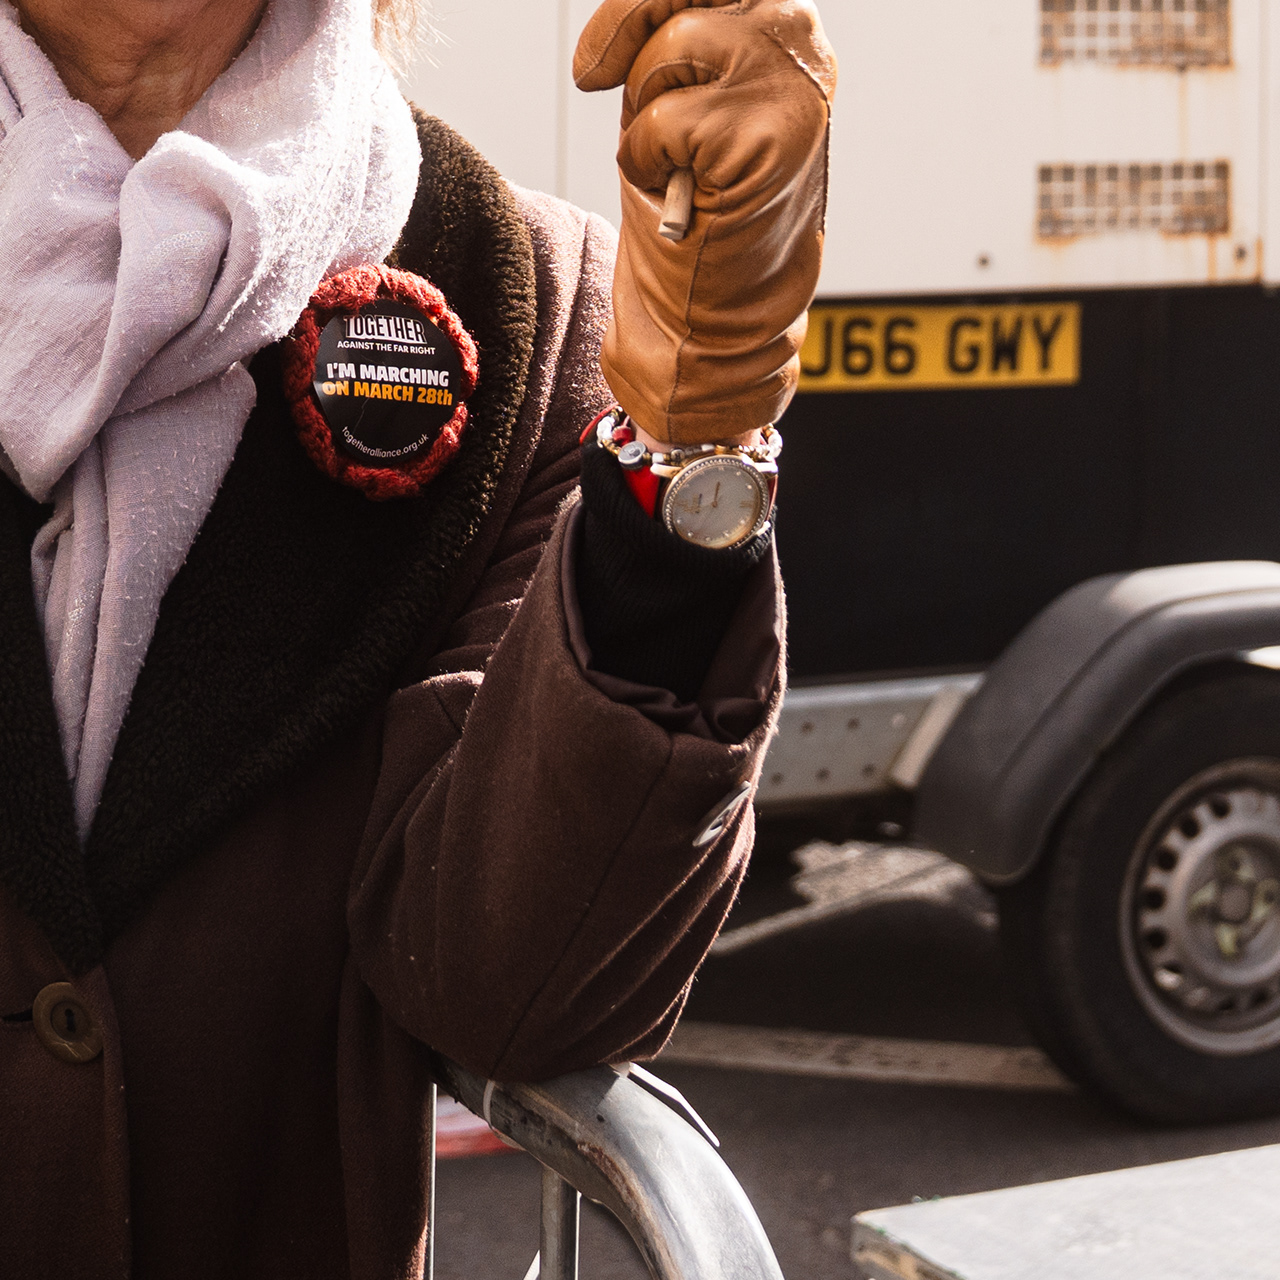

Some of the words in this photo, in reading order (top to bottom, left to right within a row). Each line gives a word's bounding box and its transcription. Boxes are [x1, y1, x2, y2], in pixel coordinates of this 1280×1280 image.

[343, 314, 428, 345] TOGETHER
[337, 340, 374, 351] AGAINST
[376, 343, 392, 352] THE
[393, 344, 409, 353] FAR
[410, 345, 436, 355] RIGHT
[799, 317, 917, 377] J66
[945, 315, 1064, 375] GWY
[326, 362, 356, 379] I'M
[359, 364, 450, 387] MARCHING
[322, 380, 350, 397] ON
[354, 381, 414, 402] MARCH
[417, 387, 453, 406] 28th
[342, 425, 429, 458] togetheralliance.org.uk
